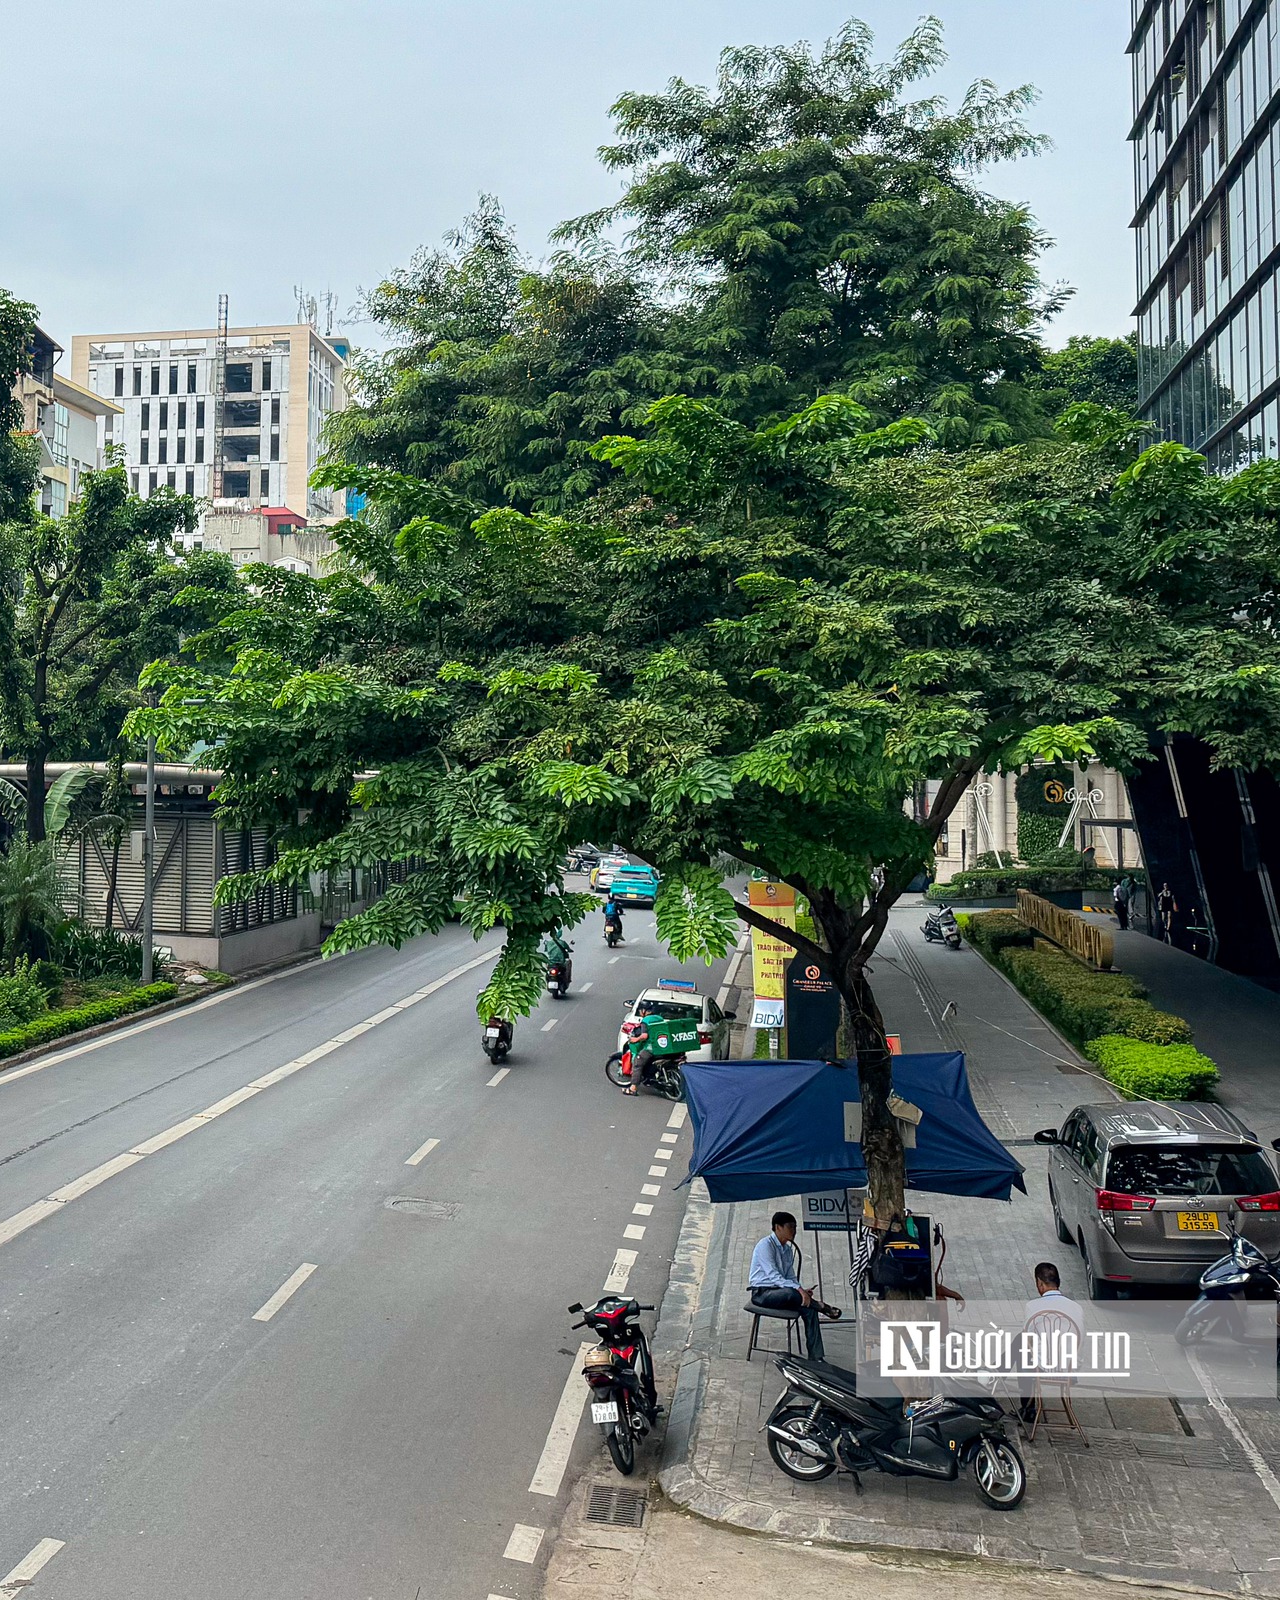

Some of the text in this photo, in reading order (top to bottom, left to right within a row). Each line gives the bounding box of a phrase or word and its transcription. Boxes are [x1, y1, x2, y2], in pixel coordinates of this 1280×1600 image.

[755, 1013, 784, 1026] BIDV
[671, 1031, 697, 1042] XFAST
[808, 1198, 846, 1212] BIDV
[1185, 1212, 1209, 1221] 29LD
[1183, 1222, 1215, 1230] 315.59
